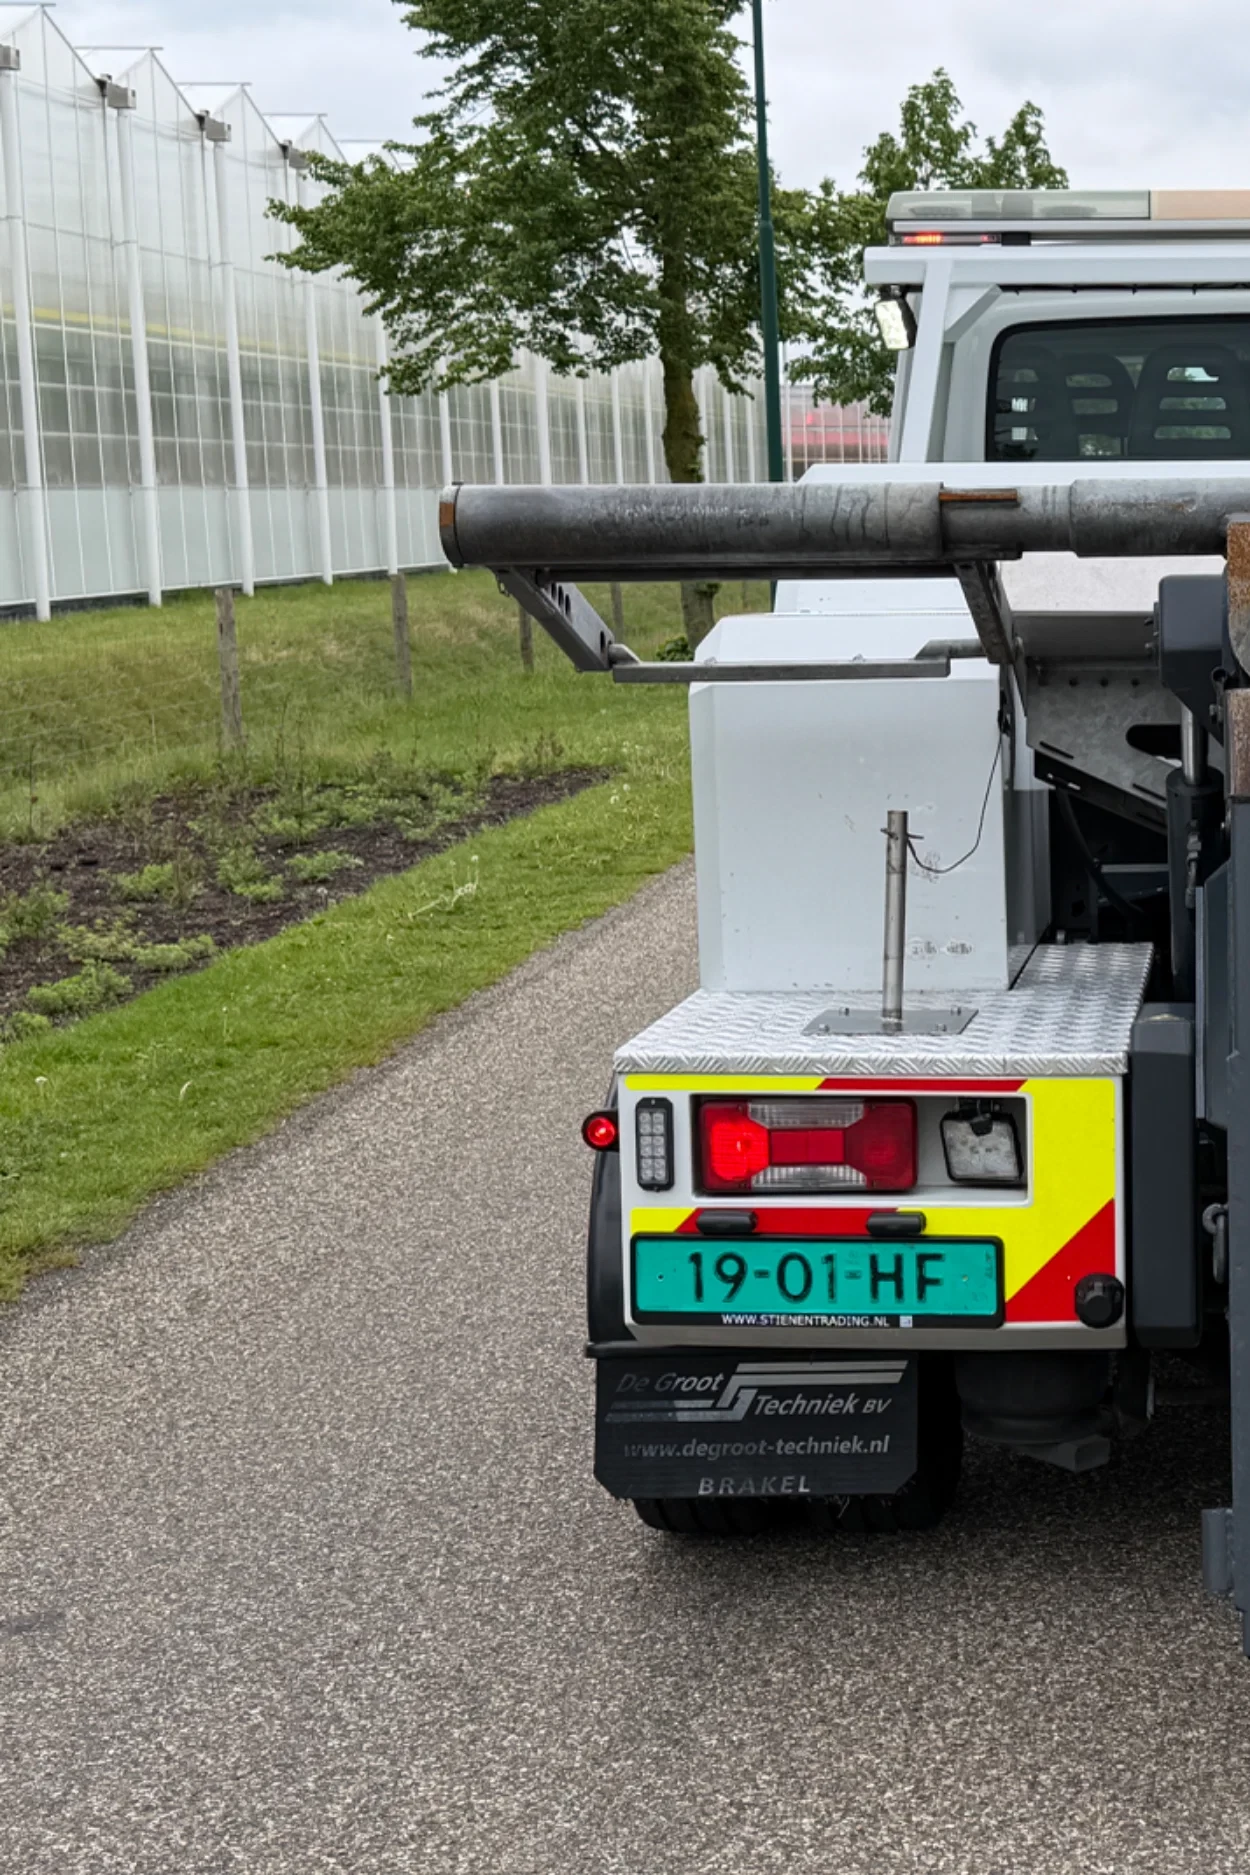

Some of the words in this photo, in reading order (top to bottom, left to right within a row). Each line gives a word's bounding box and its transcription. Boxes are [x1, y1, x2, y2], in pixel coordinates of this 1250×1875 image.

[687, 1251, 945, 1303] 19-01-HF
[721, 1313, 890, 1327] WWW.STIENENTRADING.NL
[616, 1372, 648, 1394] De
[654, 1371, 725, 1393] Groot
[753, 1393, 857, 1416] Techniek
[862, 1397, 892, 1414] BV
[622, 1434, 891, 1461] www.degroot-techniek.nl
[697, 1474, 812, 1496] BRAKEL
